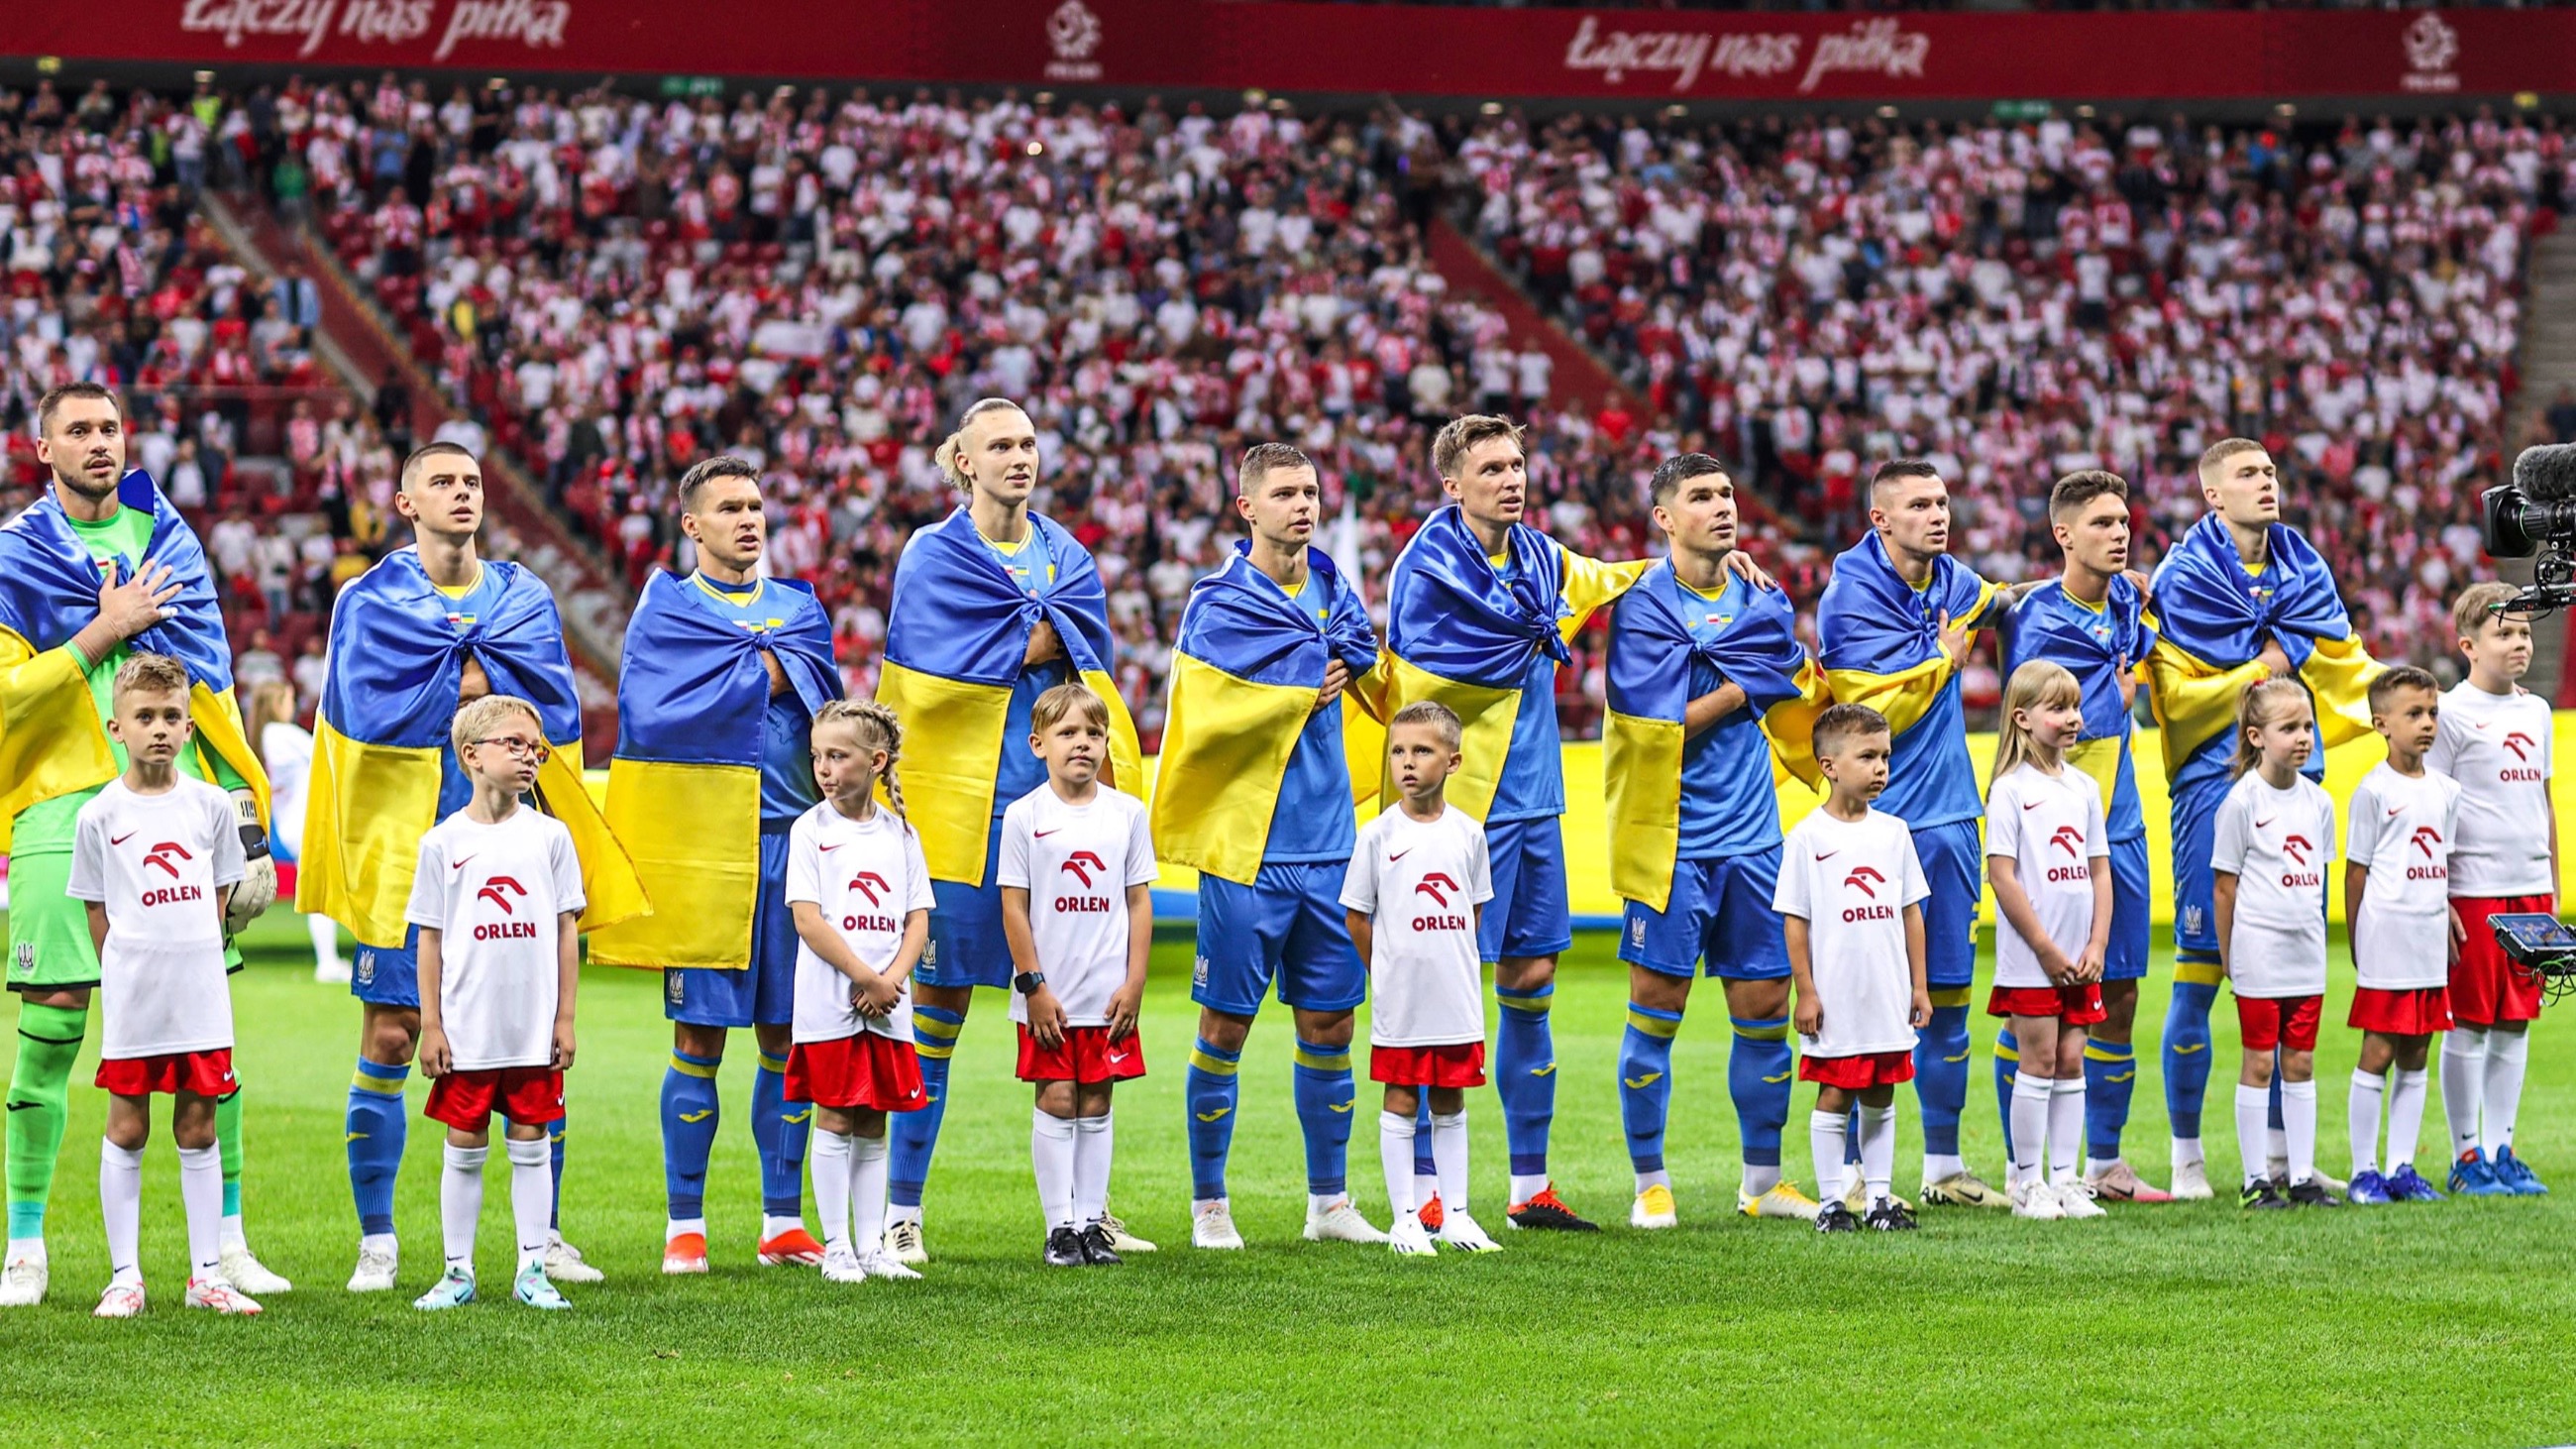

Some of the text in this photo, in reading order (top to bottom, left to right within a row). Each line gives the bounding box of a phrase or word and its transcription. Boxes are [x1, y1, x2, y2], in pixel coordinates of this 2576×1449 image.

[339, 0, 434, 44] nas
[1712, 33, 1801, 76] nas
[2500, 768, 2541, 782] ORLEN
[2282, 873, 2319, 887] ORLEN
[2408, 866, 2446, 880] ORLEN
[142, 885, 202, 907] ORLEN
[1055, 896, 1111, 913] ORLEN
[1843, 905, 1893, 923] ORLEN
[474, 922, 536, 942] ORLEN
[843, 915, 896, 933] ORLEN
[1412, 915, 1465, 933] ORLEN
